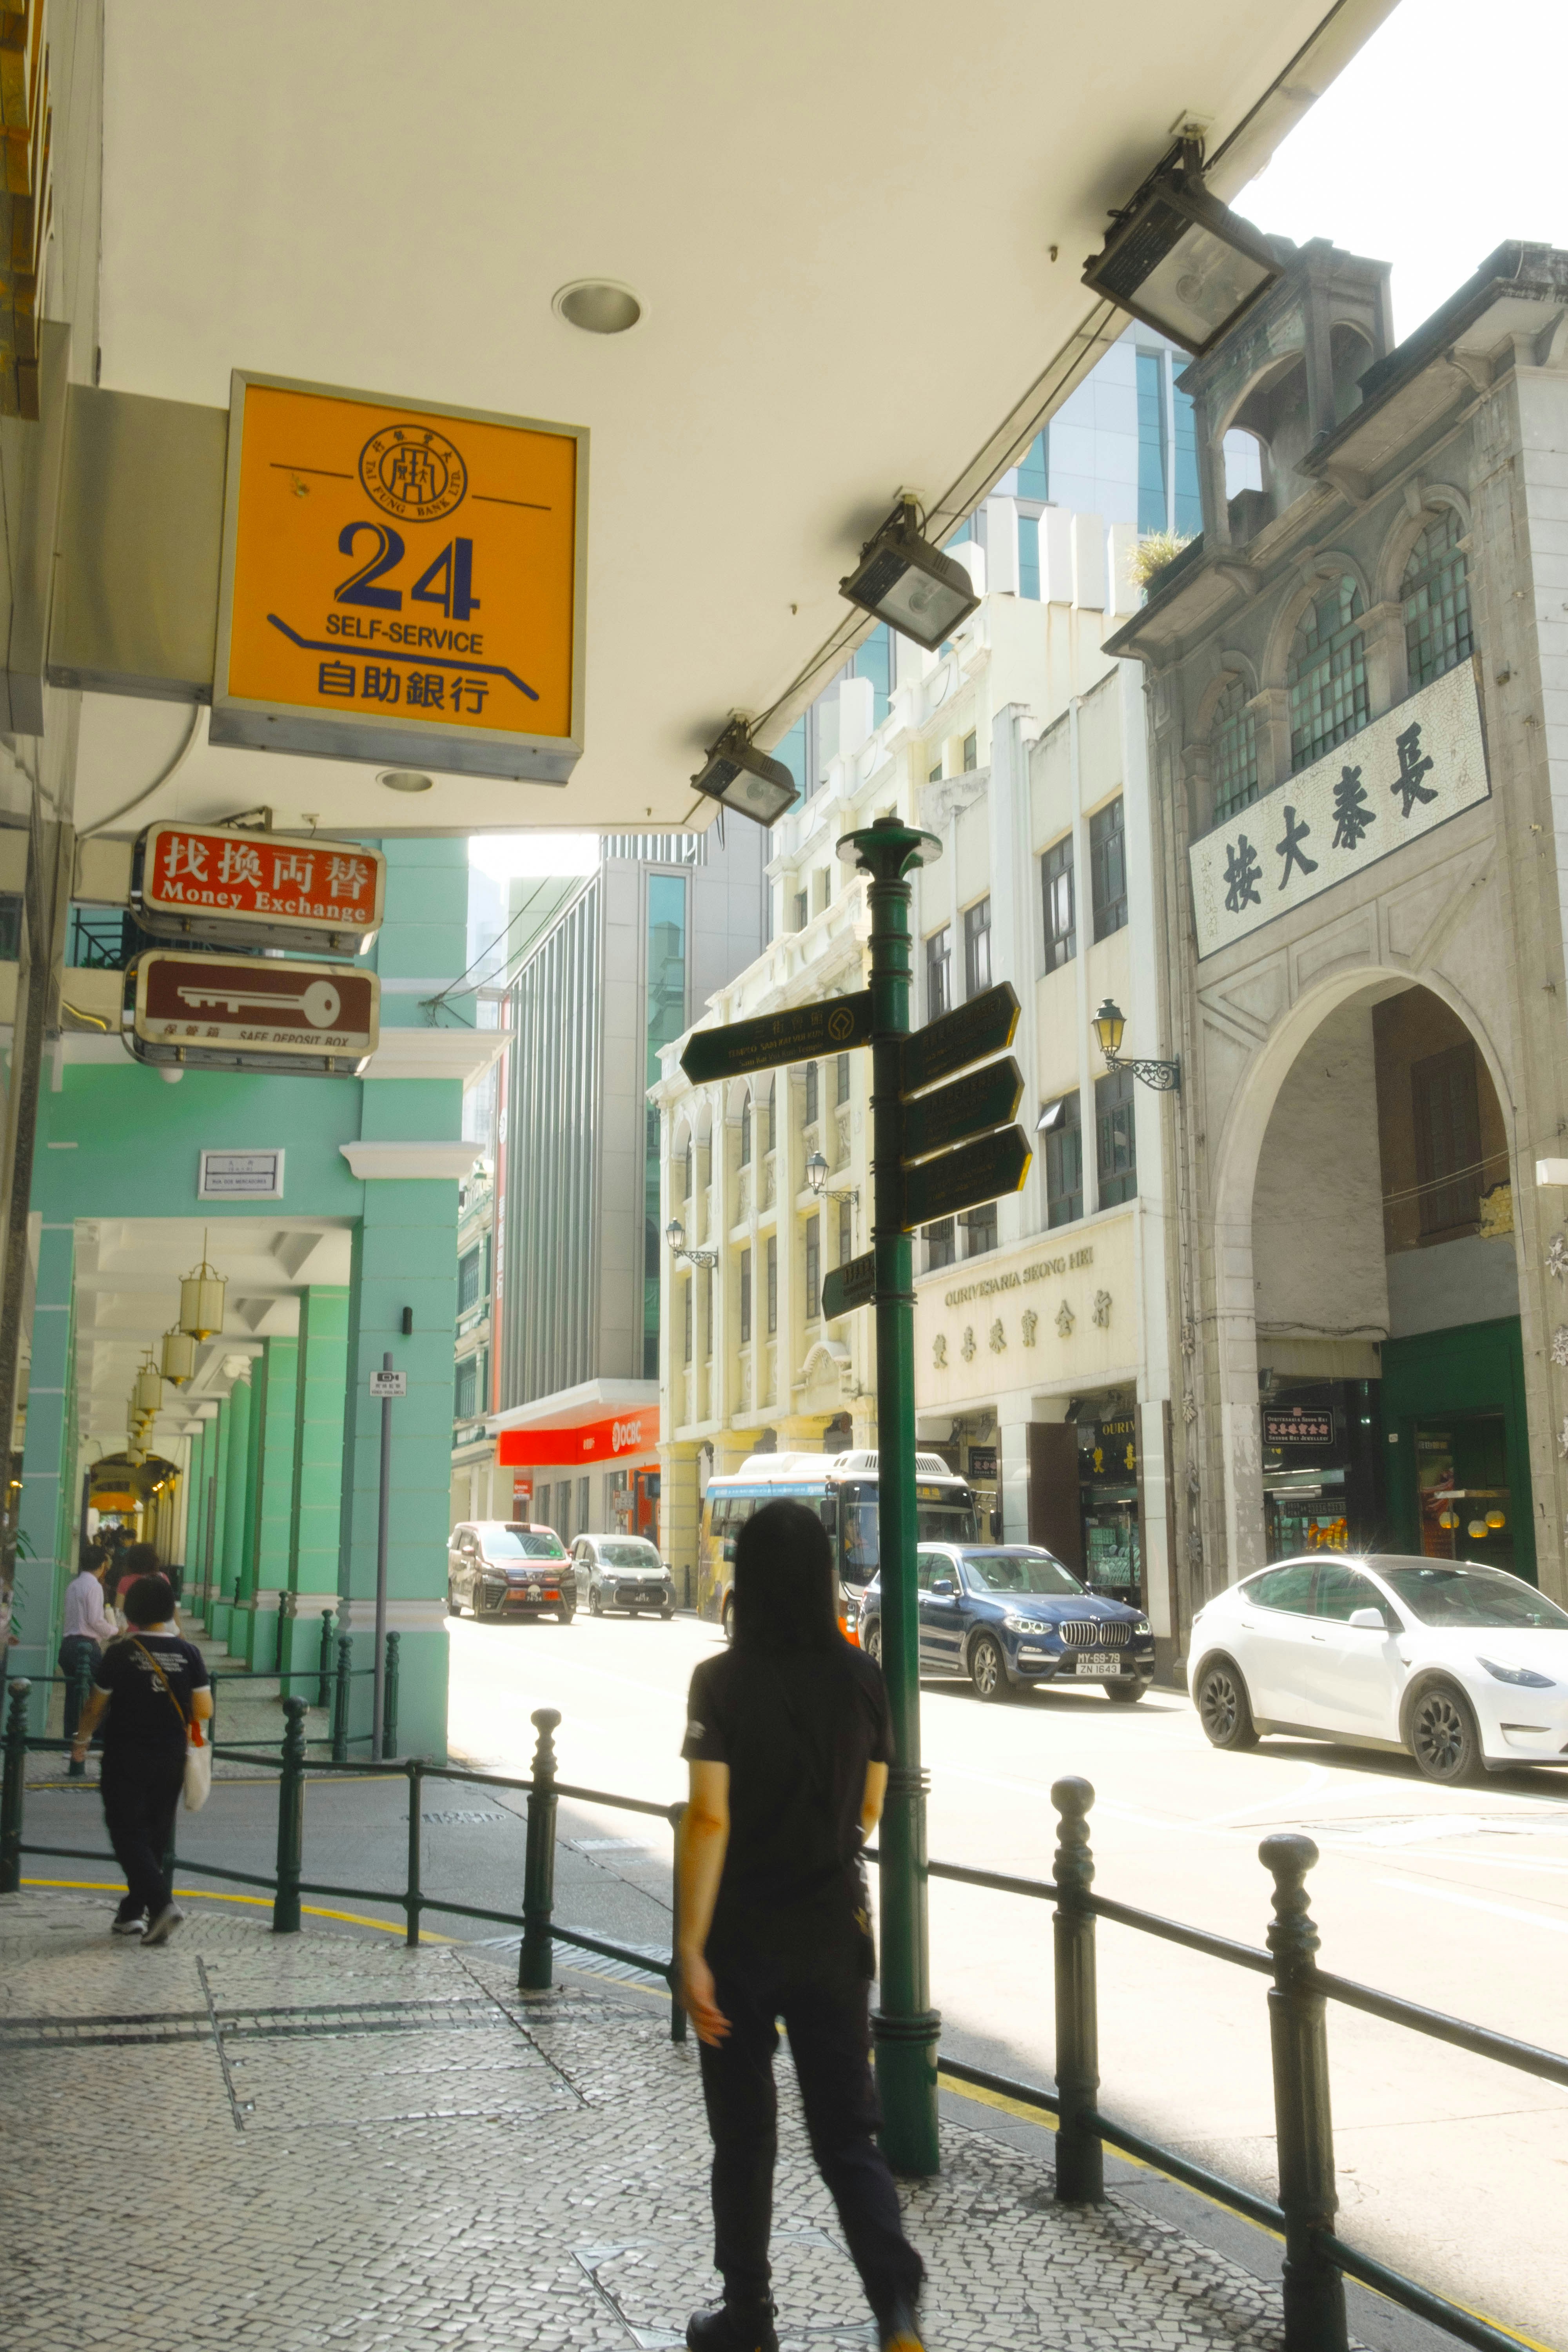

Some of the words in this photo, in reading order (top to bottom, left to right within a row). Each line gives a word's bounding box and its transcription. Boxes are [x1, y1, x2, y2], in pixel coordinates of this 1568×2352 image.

[366, 461, 377, 479] TAI
[374, 486, 405, 513] FUNG
[417, 498, 450, 515] BANK
[334, 521, 480, 621] 24
[326, 614, 483, 655] SELF-SERVICE
[318, 660, 489, 715] 自助銀行
[160, 880, 242, 910] Money
[255, 891, 366, 923] Exchange
[239, 1031, 269, 1042] SAFE
[273, 1033, 321, 1045] DEPOSIT
[325, 1037, 350, 1047] BOX
[945, 1271, 1021, 1307] OURIVESARIA
[1023, 1257, 1066, 1284] SEONG
[1069, 1246, 1094, 1270] HEI
[620, 1420, 642, 1446] OCBC
[1078, 1653, 1120, 1663] MY-69-79
[1080, 1665, 1093, 1673] ZN
[1096, 1665, 1117, 1673] 1643
